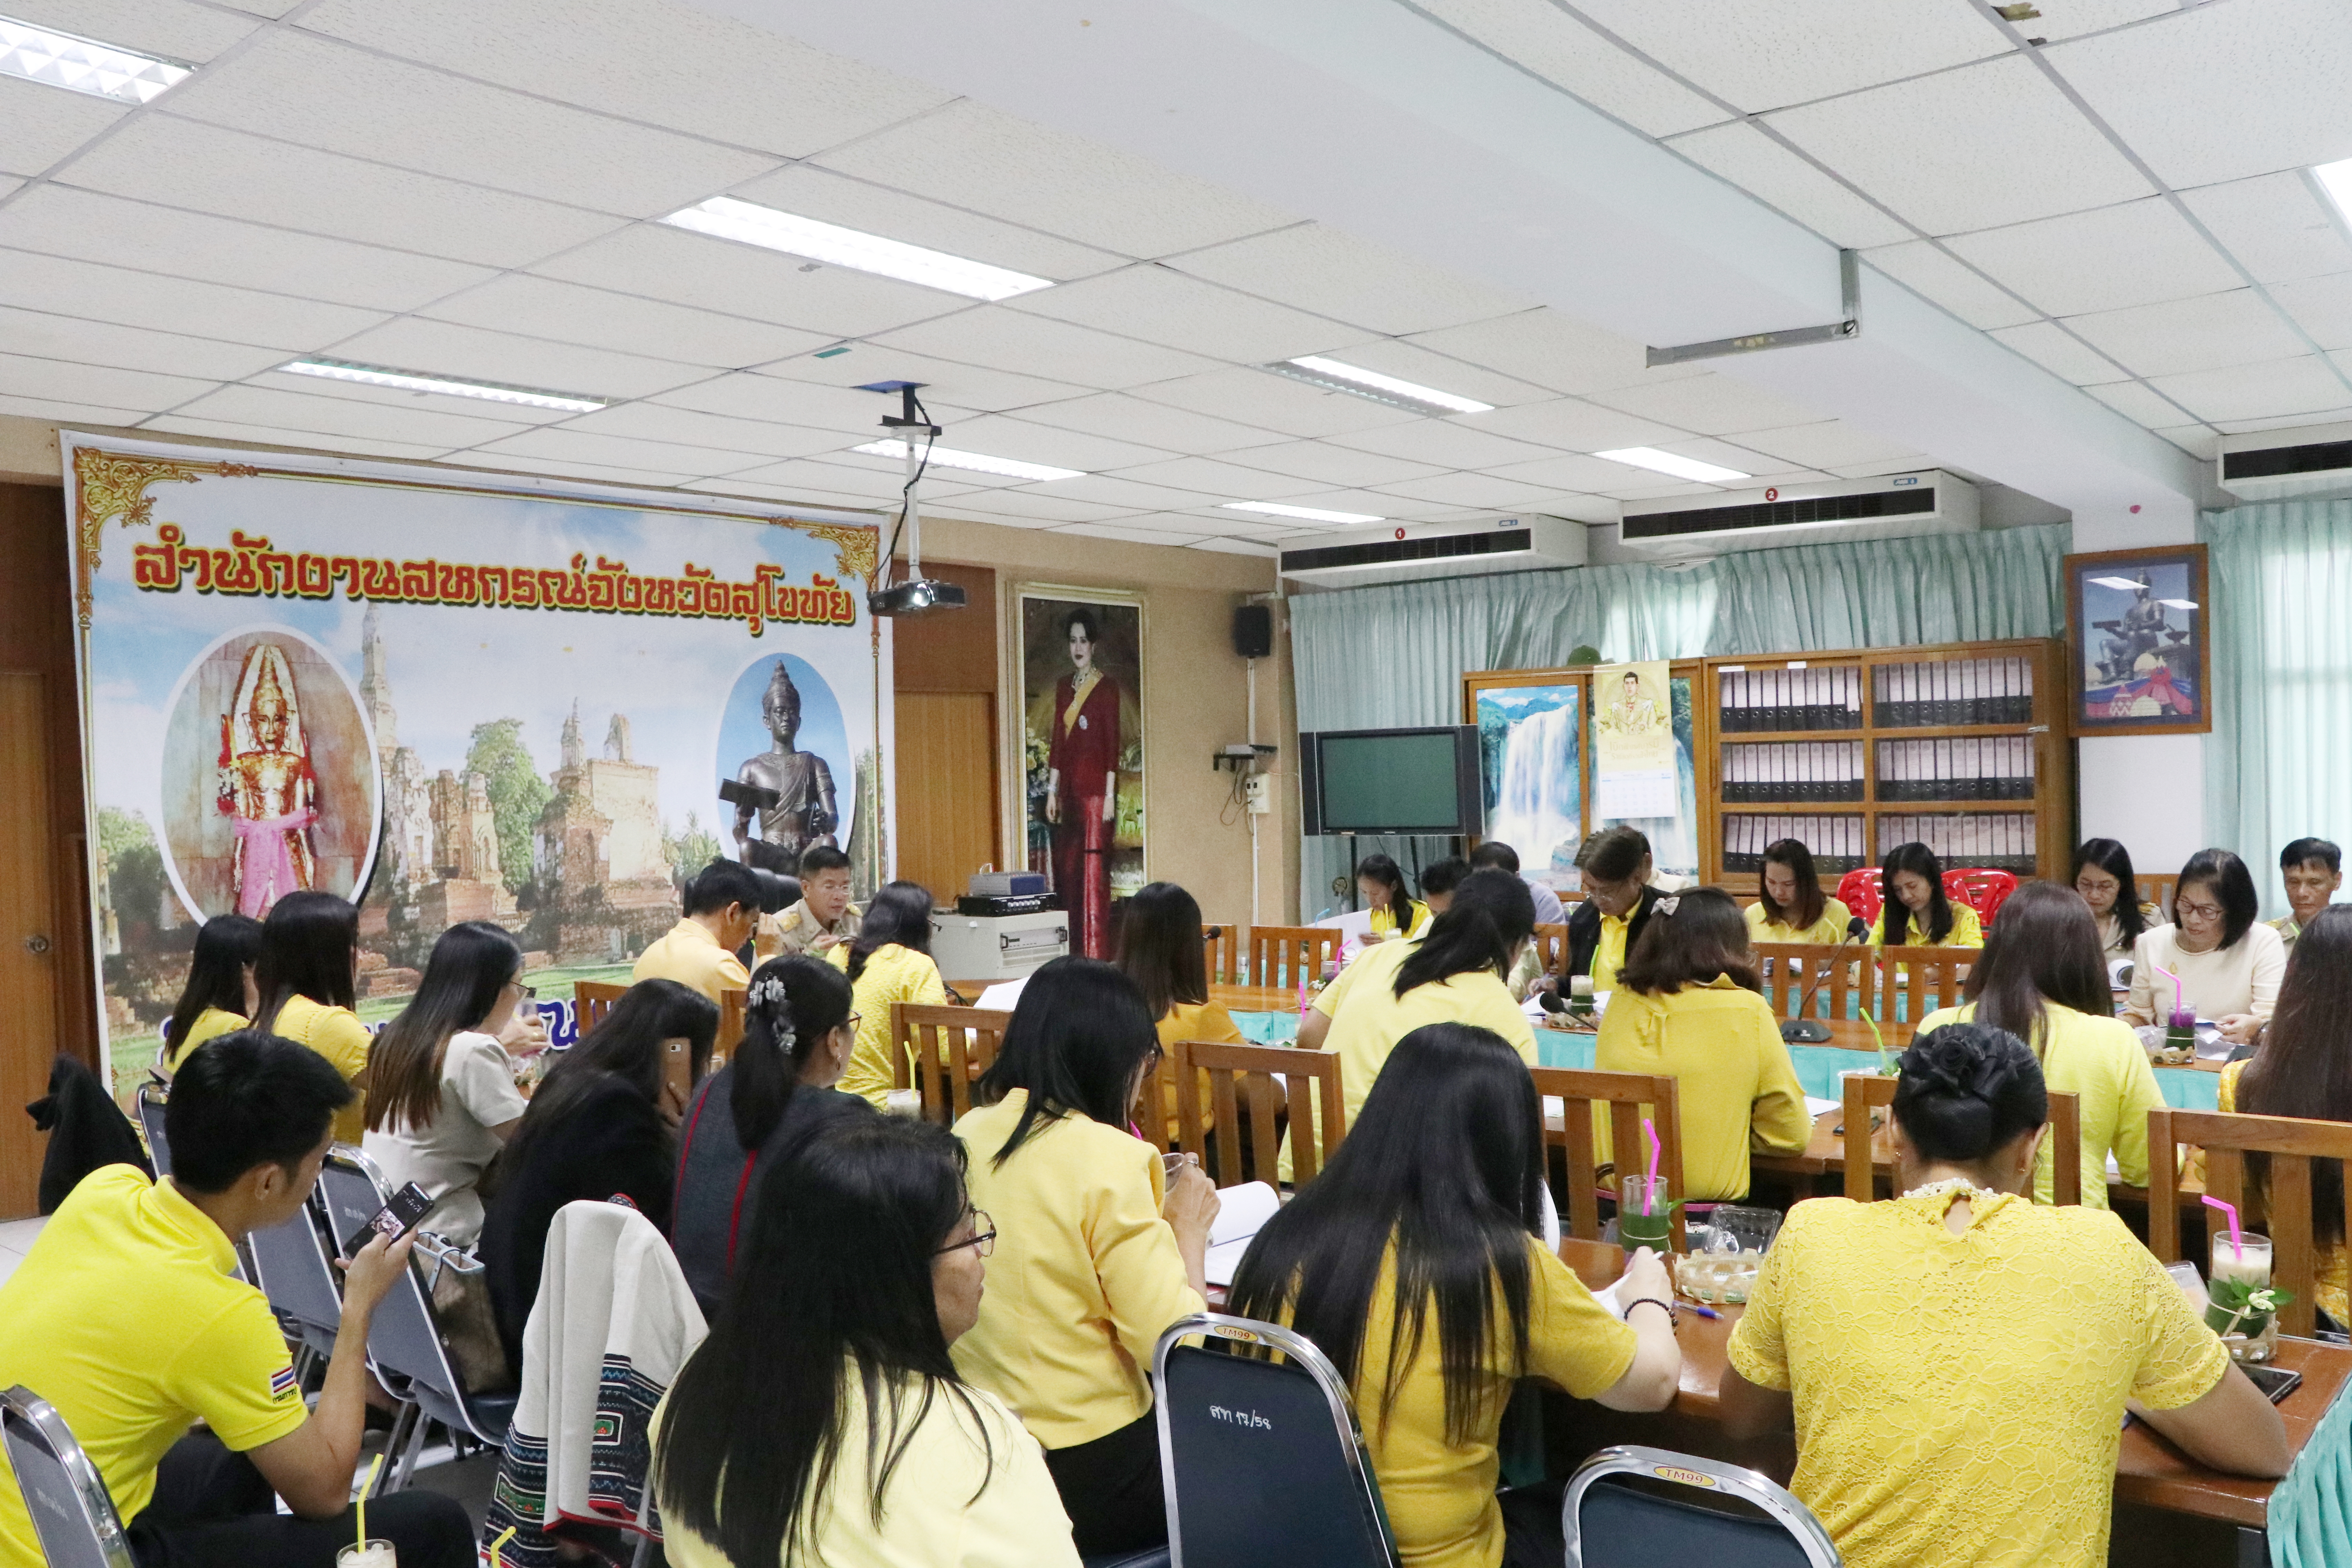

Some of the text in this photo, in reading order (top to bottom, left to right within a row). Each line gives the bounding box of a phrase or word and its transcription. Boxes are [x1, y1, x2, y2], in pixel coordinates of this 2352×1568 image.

[1768, 490, 1775, 499] 2
[133, 523, 855, 635] สำนักงานสหกรณ์จังหวัดสุโขทัย
[1223, 1327, 1250, 1339] TM99
[1665, 1468, 1703, 1484] TM99
